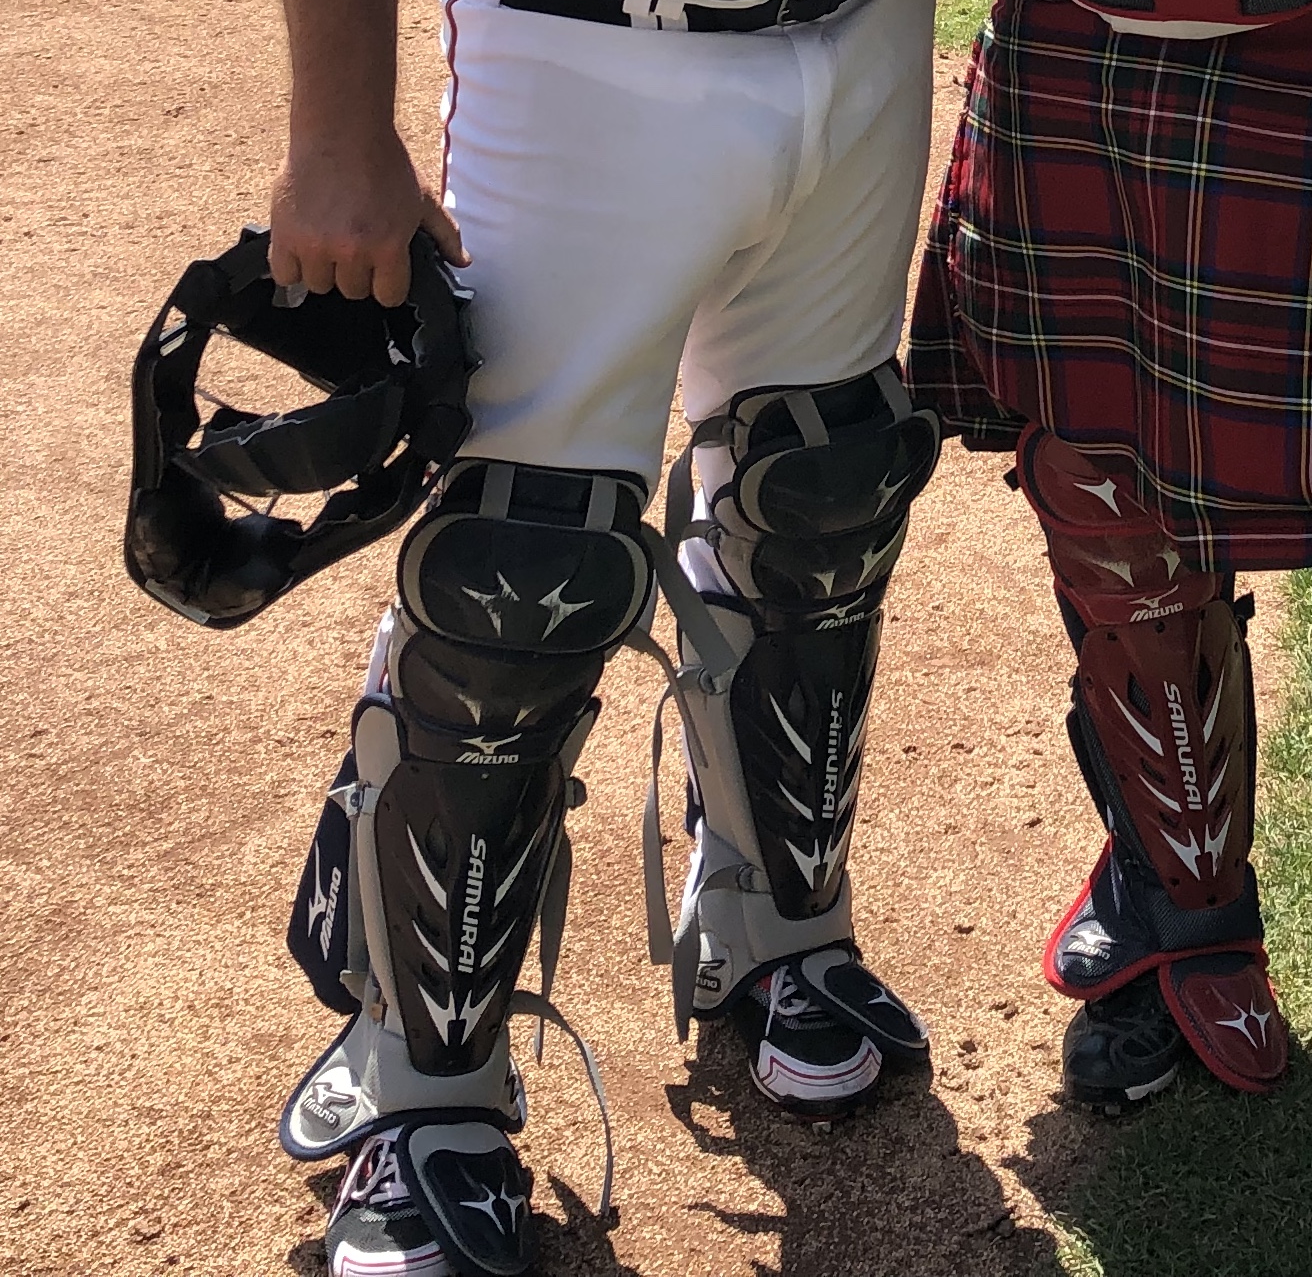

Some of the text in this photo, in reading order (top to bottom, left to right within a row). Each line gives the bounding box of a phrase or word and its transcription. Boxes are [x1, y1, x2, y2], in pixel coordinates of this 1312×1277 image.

[1129, 601, 1184, 623] MIZUNO
[455, 751, 520, 765] MIZUNO
[821, 688, 843, 819] SAMURAI
[1163, 680, 1203, 811] SAMURAI
[319, 866, 342, 962] MIZUNO
[457, 833, 487, 974] SAMURAI
[1067, 941, 1111, 961] MIZUNO
[303, 1097, 338, 1125] MIZUNO
